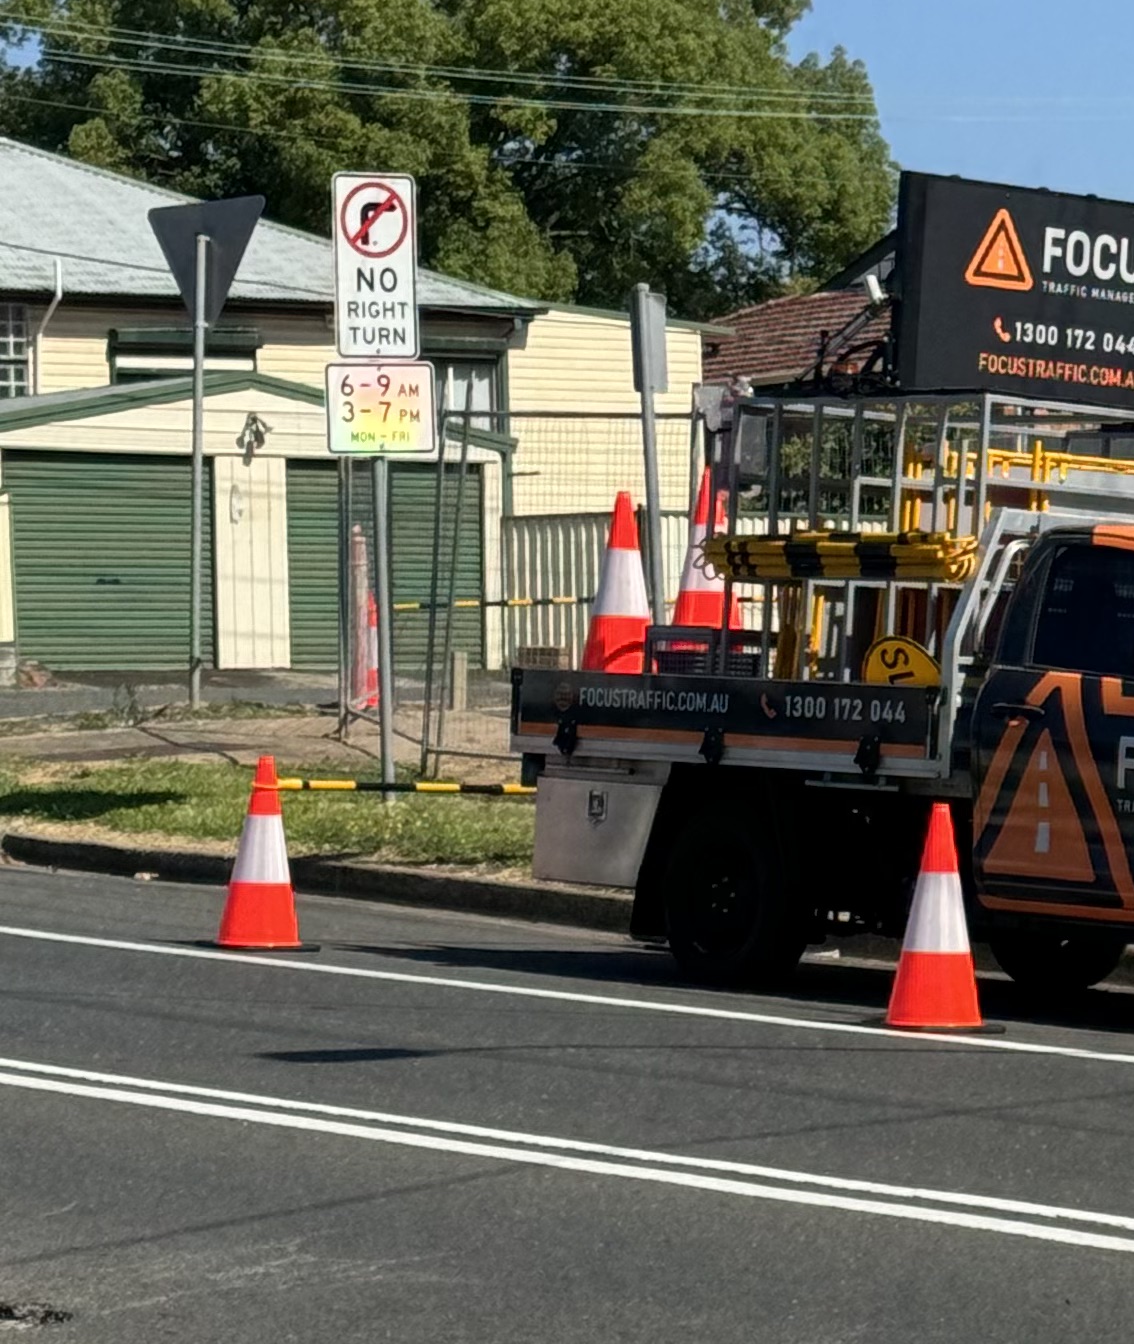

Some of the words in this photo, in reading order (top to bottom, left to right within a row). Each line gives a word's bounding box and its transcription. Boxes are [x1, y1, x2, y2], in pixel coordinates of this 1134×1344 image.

[356, 267, 398, 293] NO
[1042, 280, 1088, 298] TRAFFIC
[347, 301, 408, 320] RIGHT
[349, 326, 406, 346] TURN
[1015, 321, 1059, 346] 1300
[1066, 328, 1096, 351] 172
[397, 383, 420, 398] AM
[399, 408, 421, 424] PM
[350, 431, 376, 443] MON
[391, 431, 410, 443] FRI
[578, 687, 730, 714] FOCUSTRAFFIC.COM.AU
[785, 695, 827, 719] 1300
[833, 697, 863, 721] 172
[869, 699, 906, 724] 044
